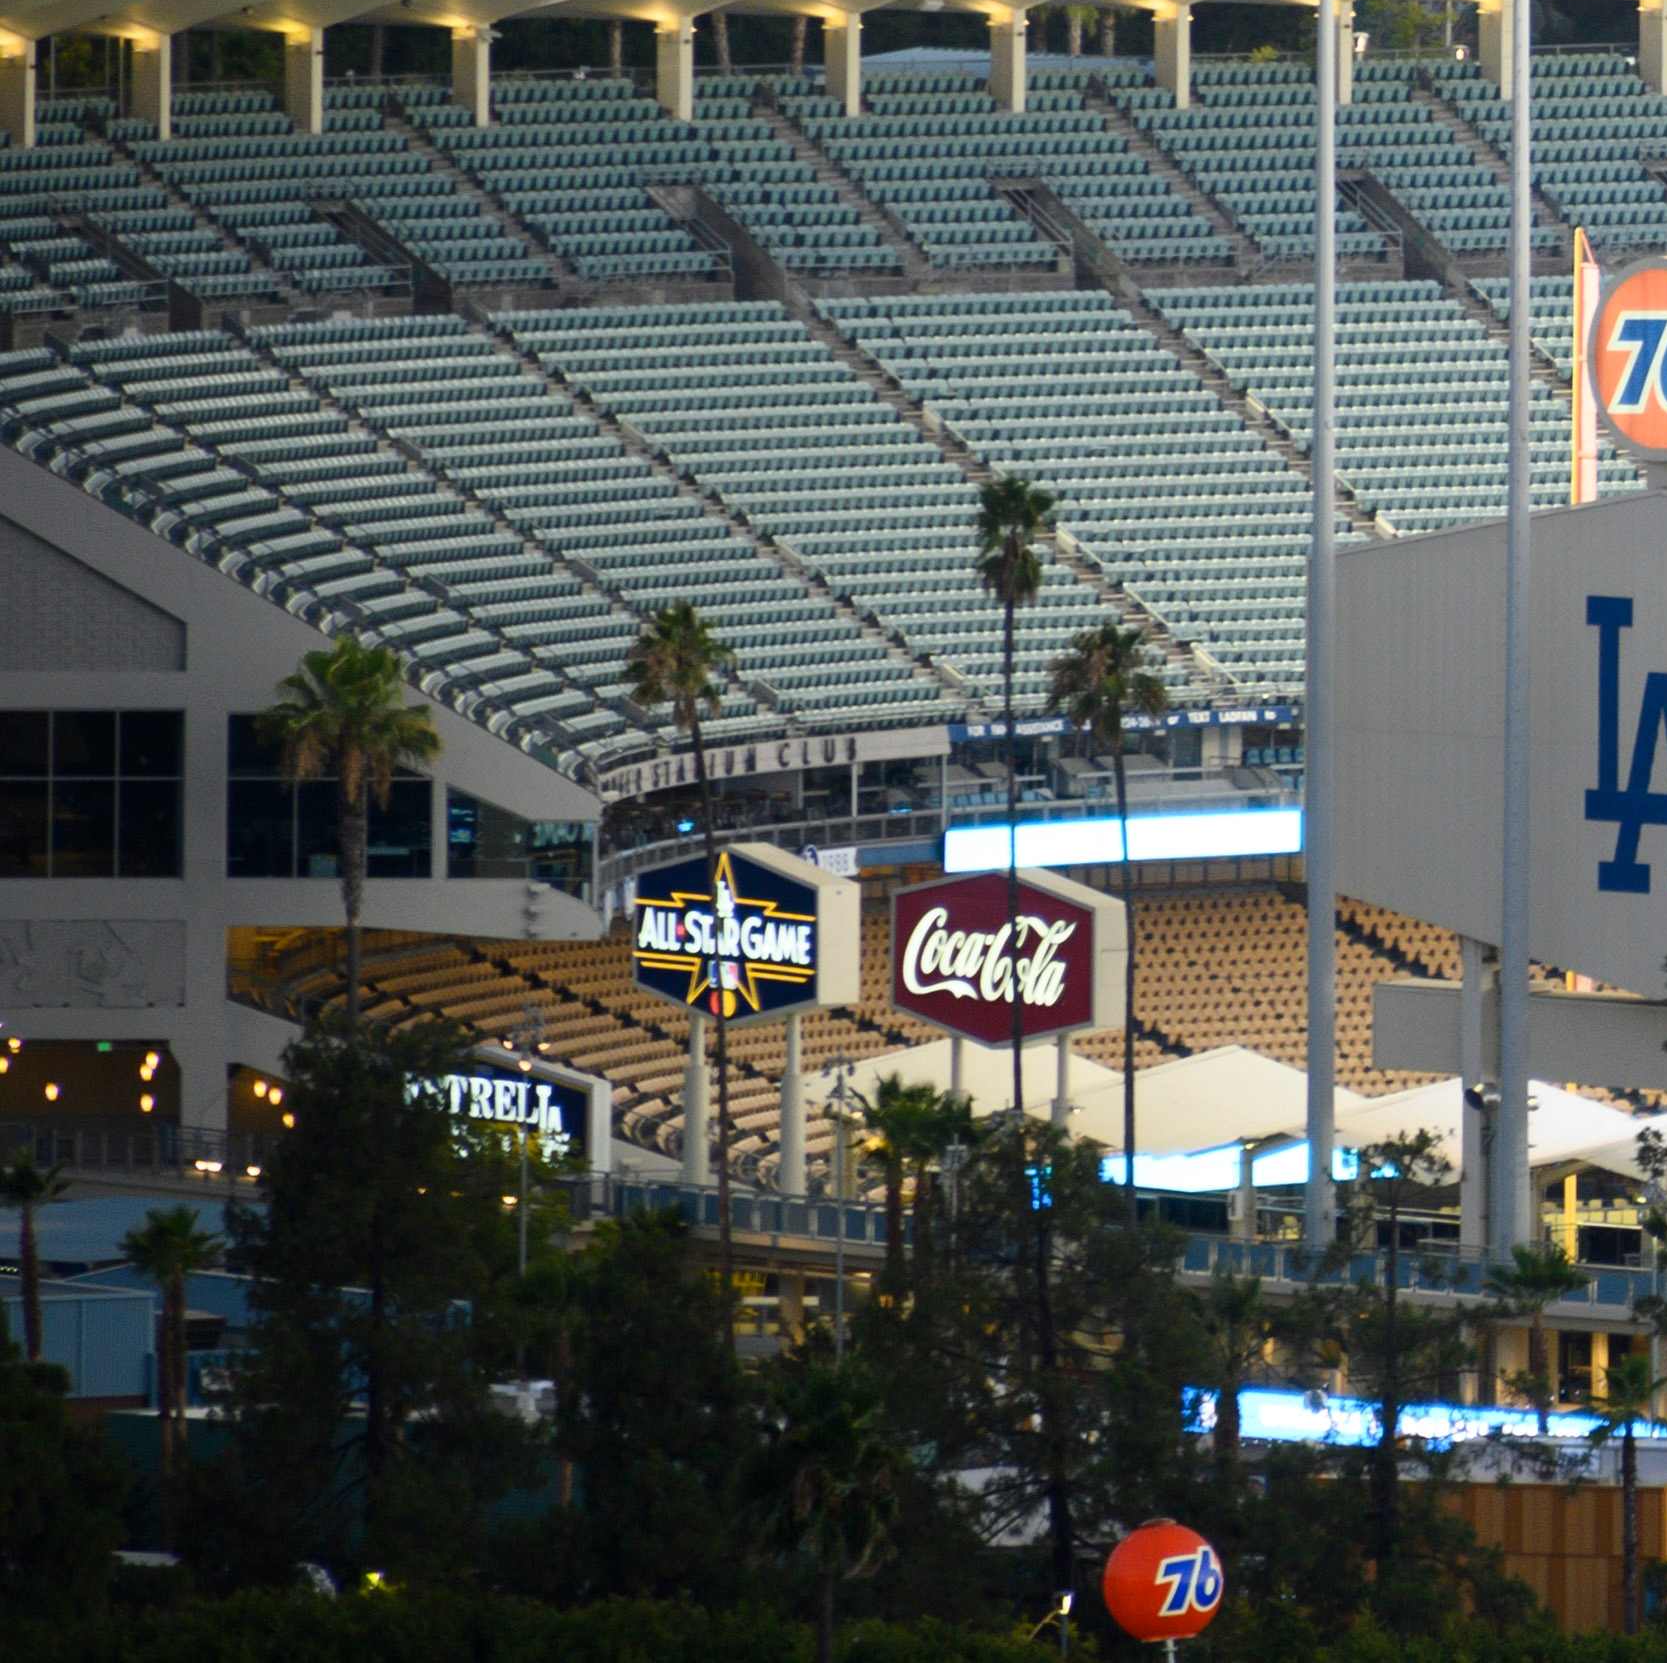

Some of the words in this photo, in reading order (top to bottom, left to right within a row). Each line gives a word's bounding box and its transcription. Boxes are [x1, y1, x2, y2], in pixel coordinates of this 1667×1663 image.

[777, 736, 858, 767] CLUB
[741, 916, 812, 966] GAME
[902, 906, 1078, 1007] Coca-Cola
[1154, 1545, 1224, 1616] 76
